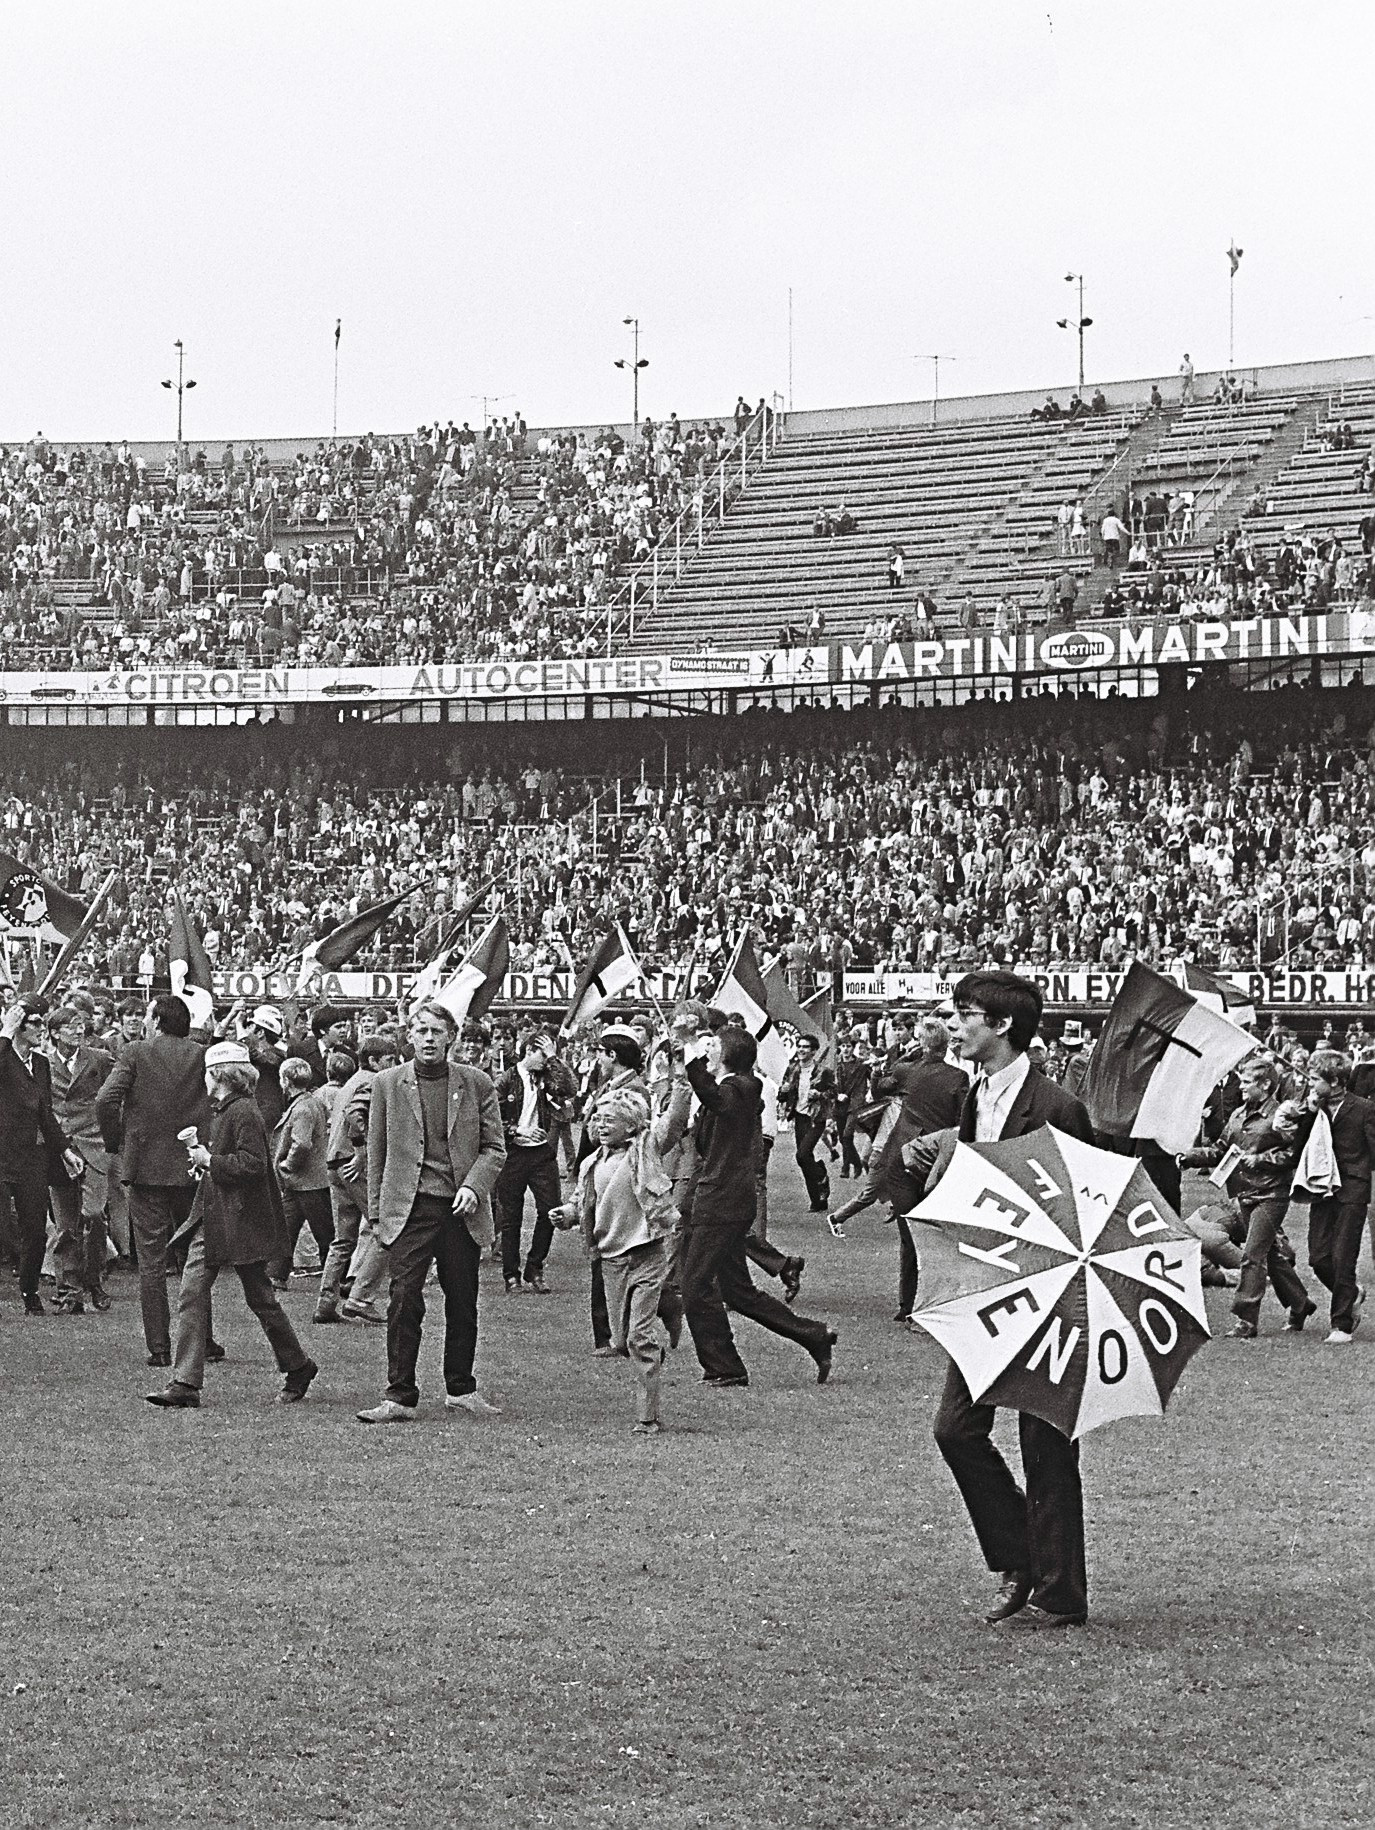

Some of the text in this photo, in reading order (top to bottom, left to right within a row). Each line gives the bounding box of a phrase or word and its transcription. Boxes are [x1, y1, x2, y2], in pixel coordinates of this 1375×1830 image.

[1051, 643, 1103, 657] MARTINI
[1120, 615, 1327, 665] MARTINI
[842, 635, 1035, 681] MARTINI
[125, 659, 663, 700] CITROEN AUTOCENTER
[372, 974, 413, 998] DE
[846, 981, 885, 994] VOOR ALLE
[1248, 974, 1334, 1002] BEDR.
